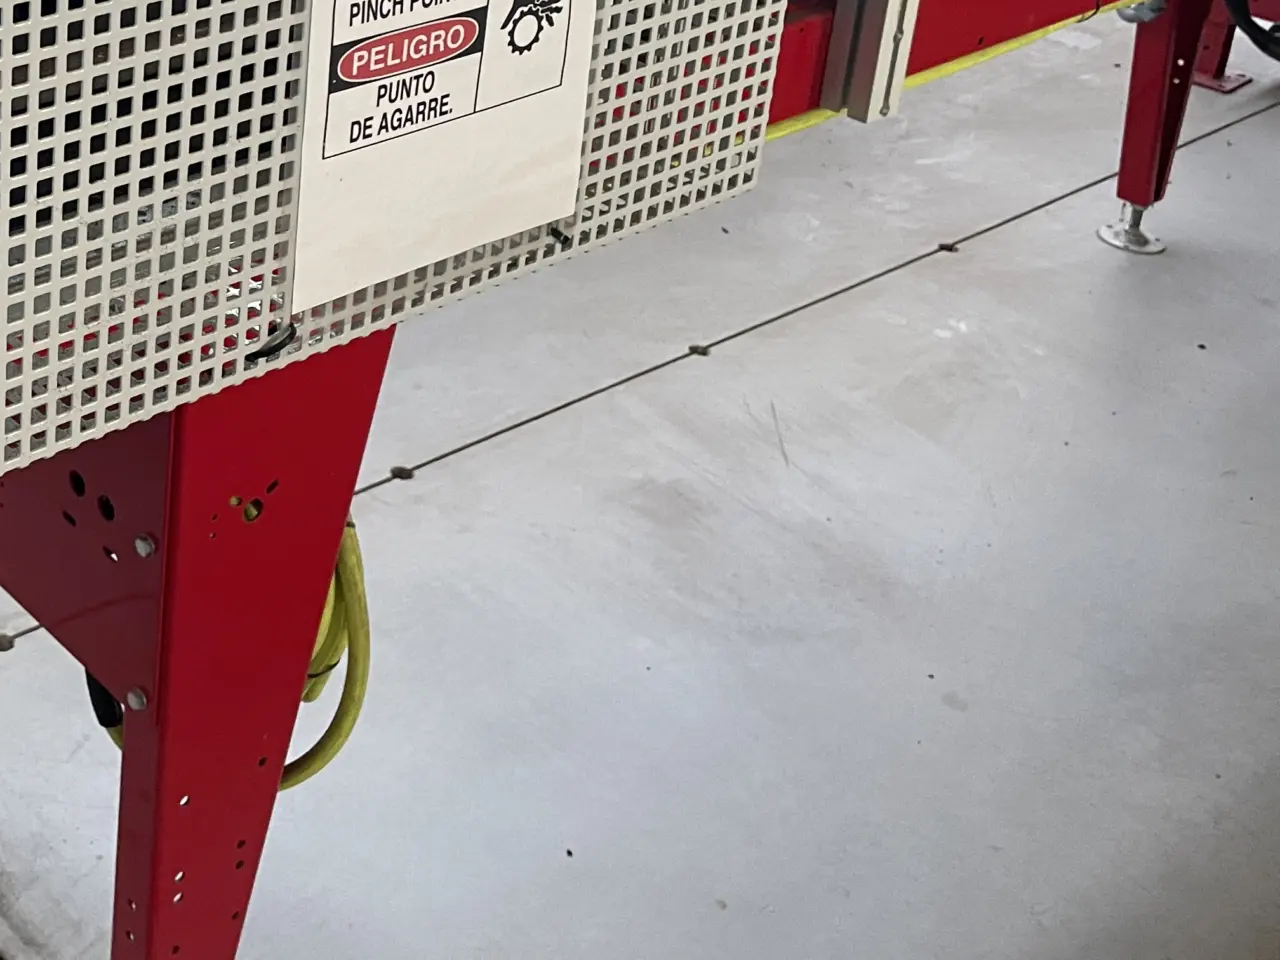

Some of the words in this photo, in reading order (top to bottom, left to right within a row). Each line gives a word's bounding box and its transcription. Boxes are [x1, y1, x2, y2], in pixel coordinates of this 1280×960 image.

[351, 25, 465, 75] PELIGRO
[376, 71, 435, 107] PUNTO
[349, 116, 373, 143] DE
[377, 94, 453, 136] AGARRE.
